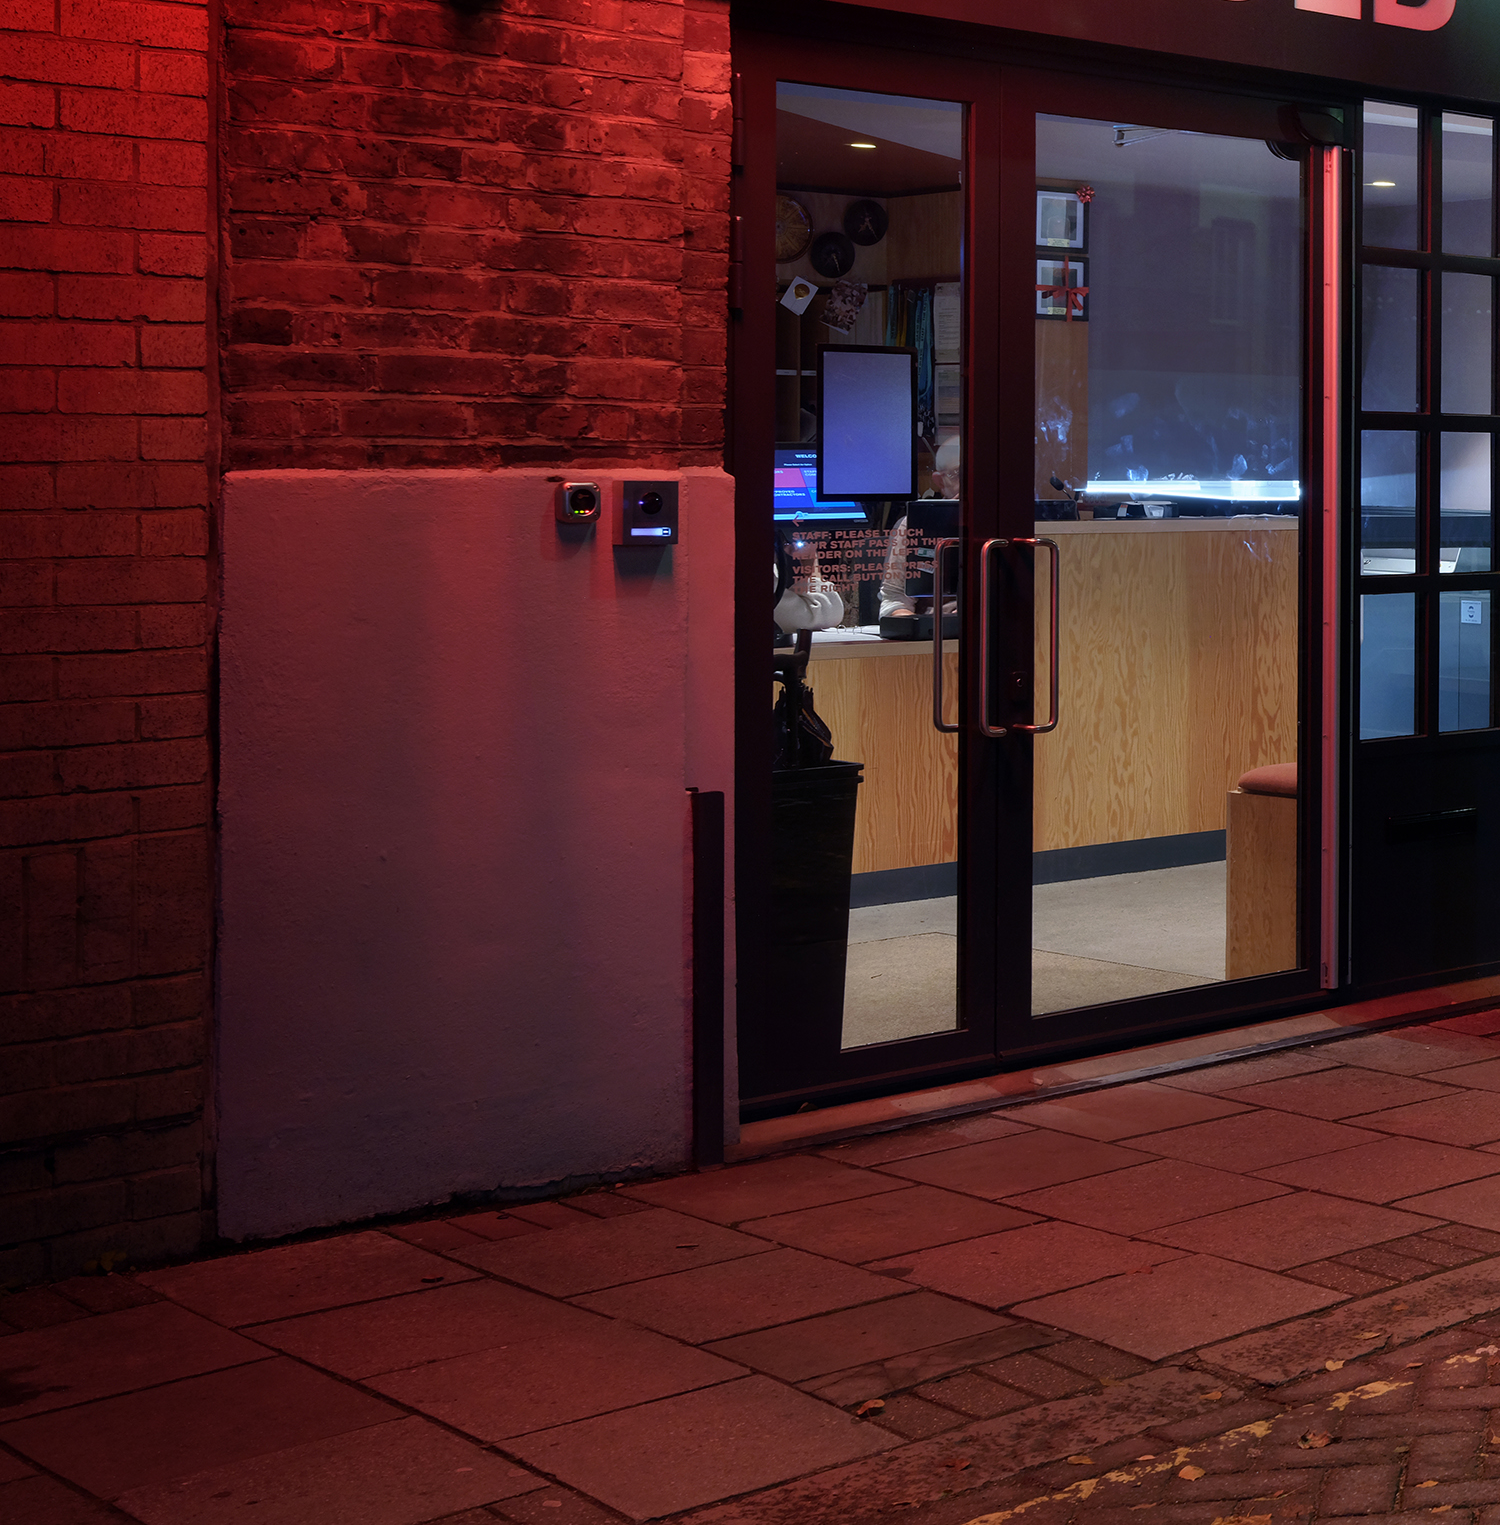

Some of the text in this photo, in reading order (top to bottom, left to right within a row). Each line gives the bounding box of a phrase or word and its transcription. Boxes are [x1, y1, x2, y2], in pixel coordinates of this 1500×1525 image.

[792, 528, 924, 540] STAFF: PLEASE TOUCH
[792, 541, 827, 550] YUR
[830, 539, 866, 549] STAFF
[868, 538, 898, 548] PASS
[902, 538, 918, 546] ON
[792, 547, 919, 560] READER ON THE LEFT
[792, 560, 938, 574] VISITORS: PLEASE PRESS
[792, 570, 922, 584] THE CALL BUTTON ON
[793, 583, 857, 594] THE RIGHT
